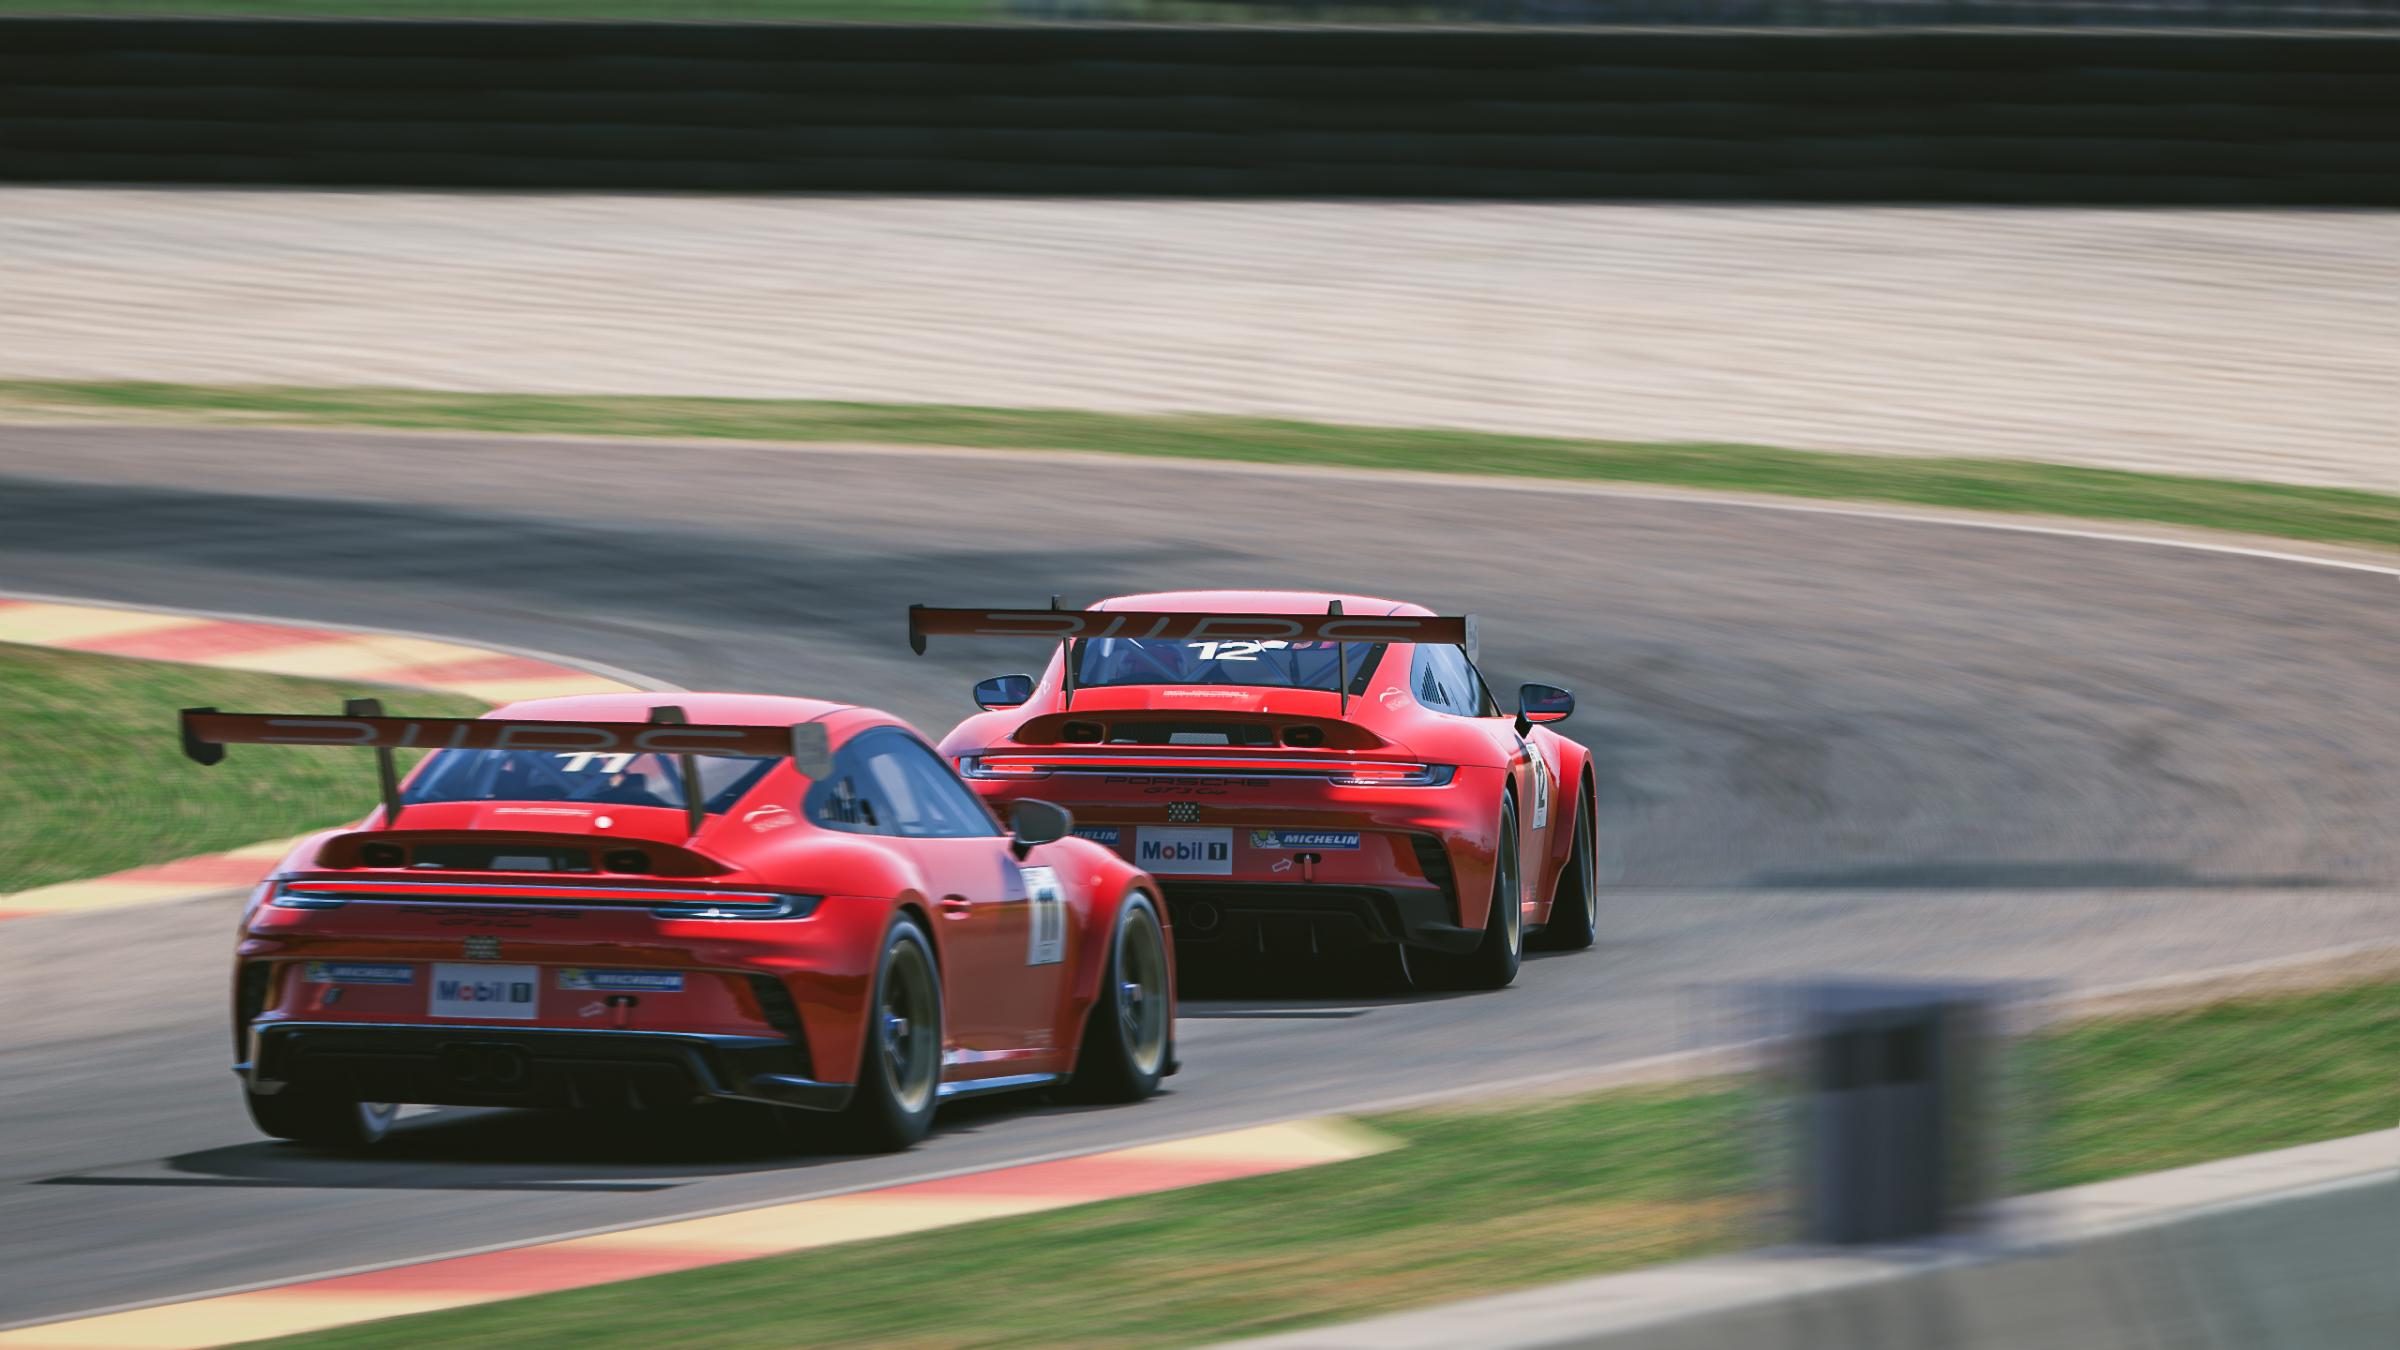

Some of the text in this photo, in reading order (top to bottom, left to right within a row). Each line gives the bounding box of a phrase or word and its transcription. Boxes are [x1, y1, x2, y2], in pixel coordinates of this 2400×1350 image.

[1104, 775, 1271, 787] PORSCHE
[1284, 832, 1358, 845] MICHELIN
[1142, 841, 1202, 861] Mobil
[437, 981, 506, 1002] Mobil
